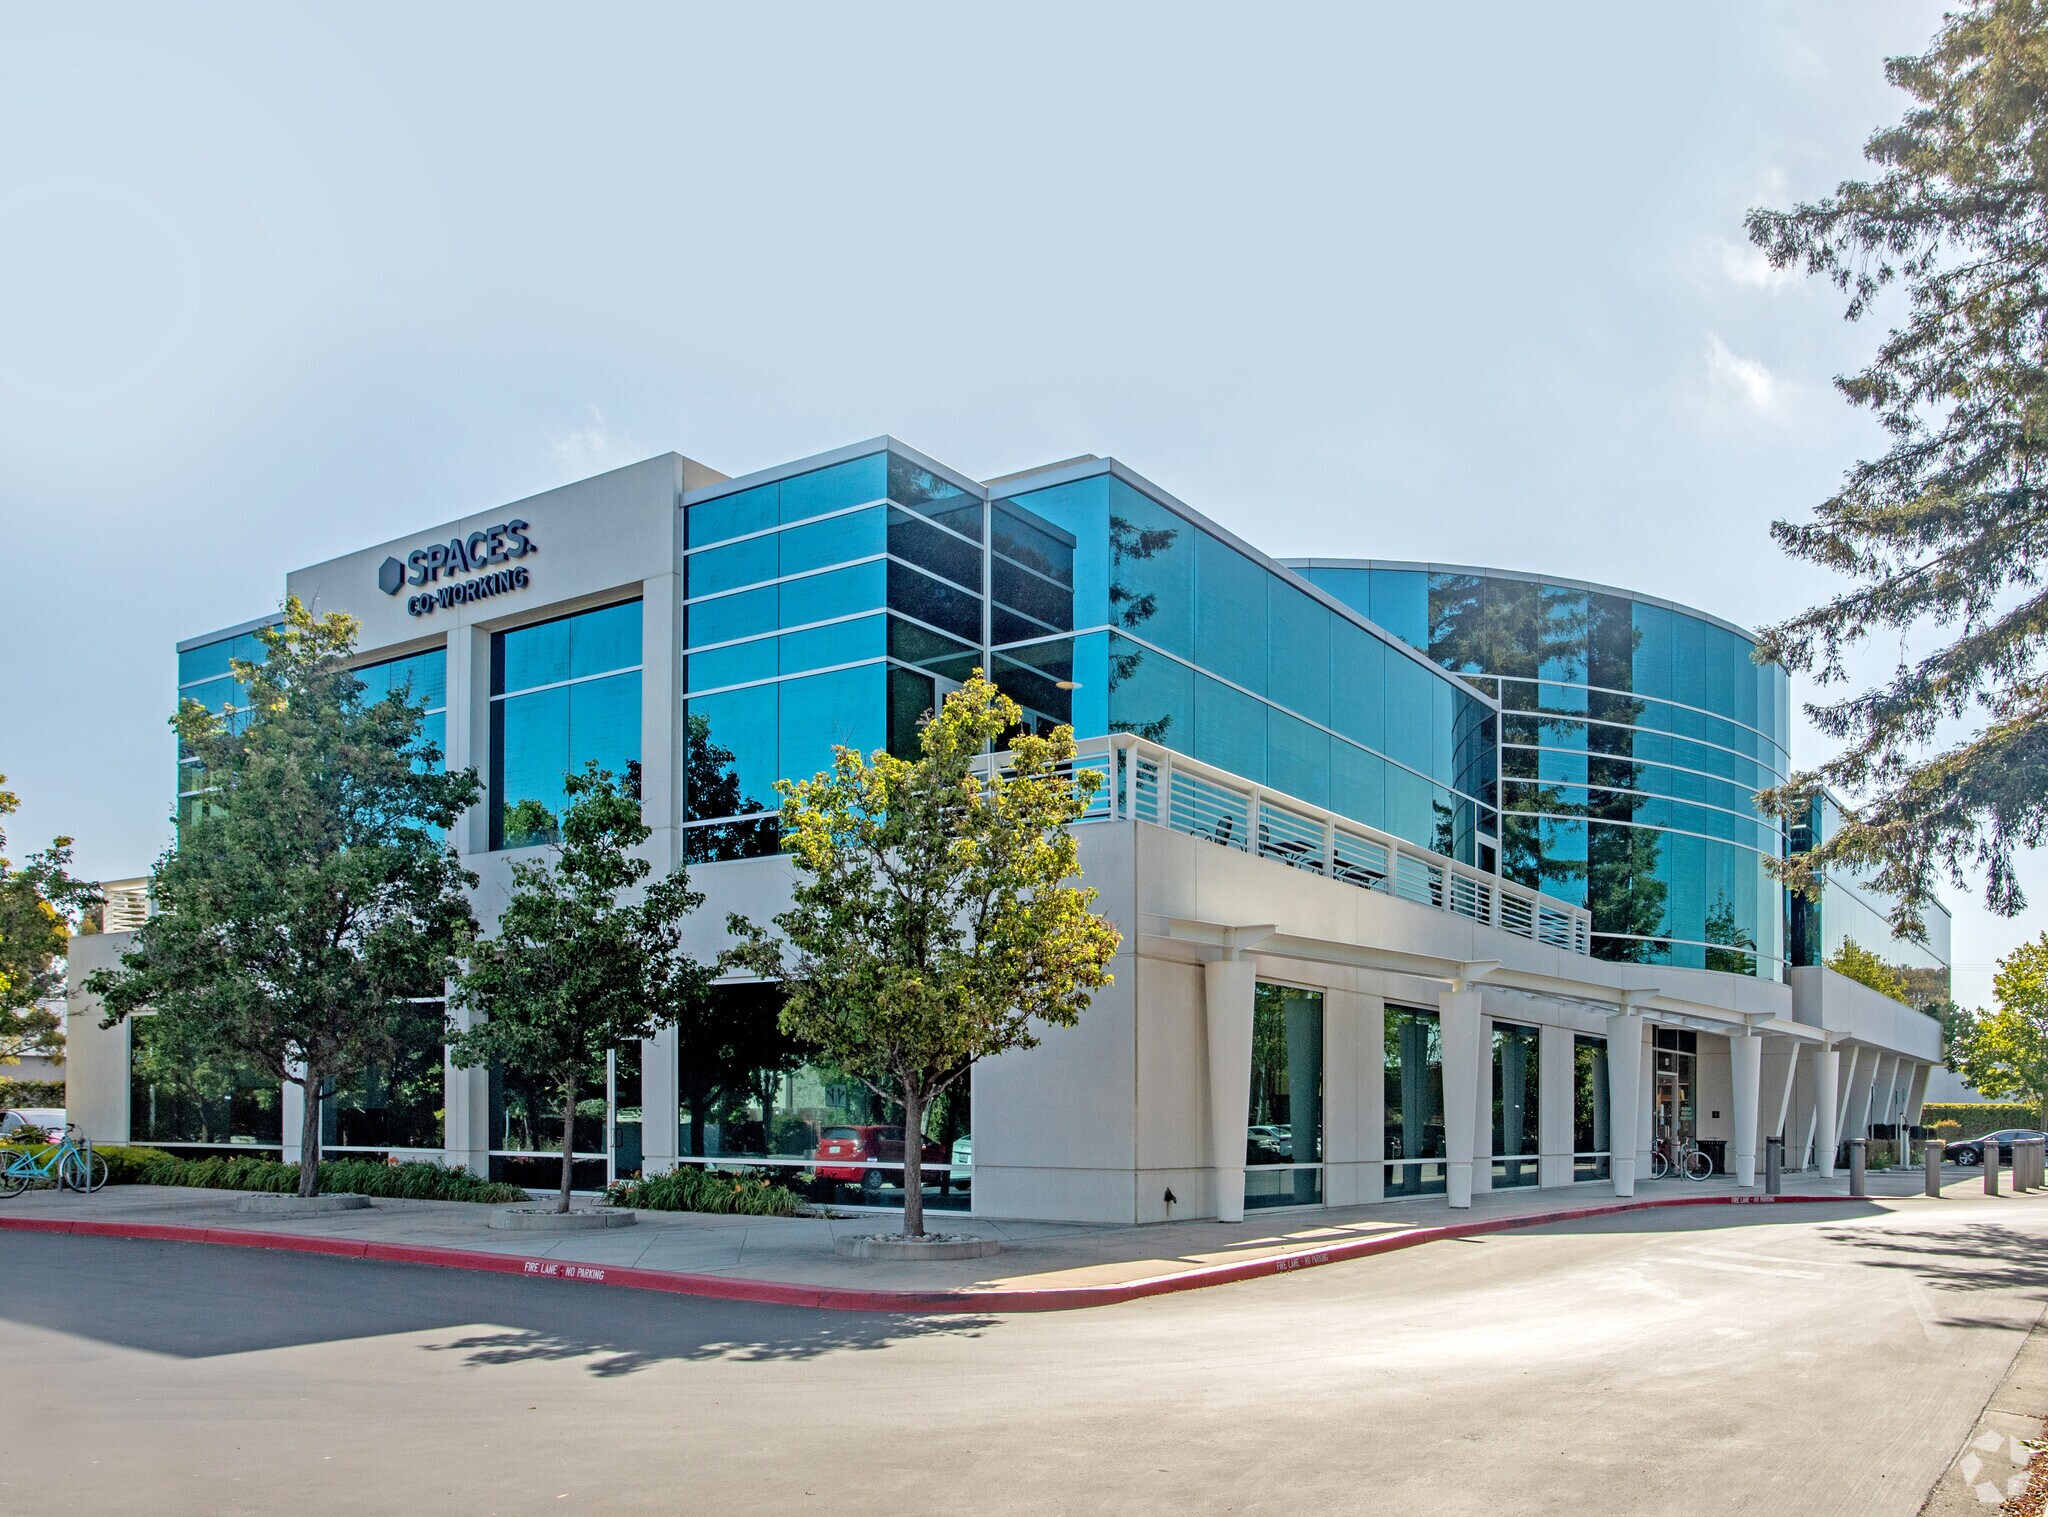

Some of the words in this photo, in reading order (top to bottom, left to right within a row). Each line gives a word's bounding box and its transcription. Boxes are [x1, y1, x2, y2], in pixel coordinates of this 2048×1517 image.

[407, 519, 538, 586] SPACES.
[407, 566, 529, 617] CO-WORKING
[524, 1262, 539, 1272] FIRE
[541, 1264, 558, 1274] LANE
[566, 1266, 575, 1276] NO
[577, 1268, 604, 1280] PARKING
[1276, 1261, 1287, 1270] FIRE
[1288, 1258, 1300, 1268] LANE
[1304, 1256, 1311, 1265] NO
[1312, 1253, 1328, 1264] PARKING
